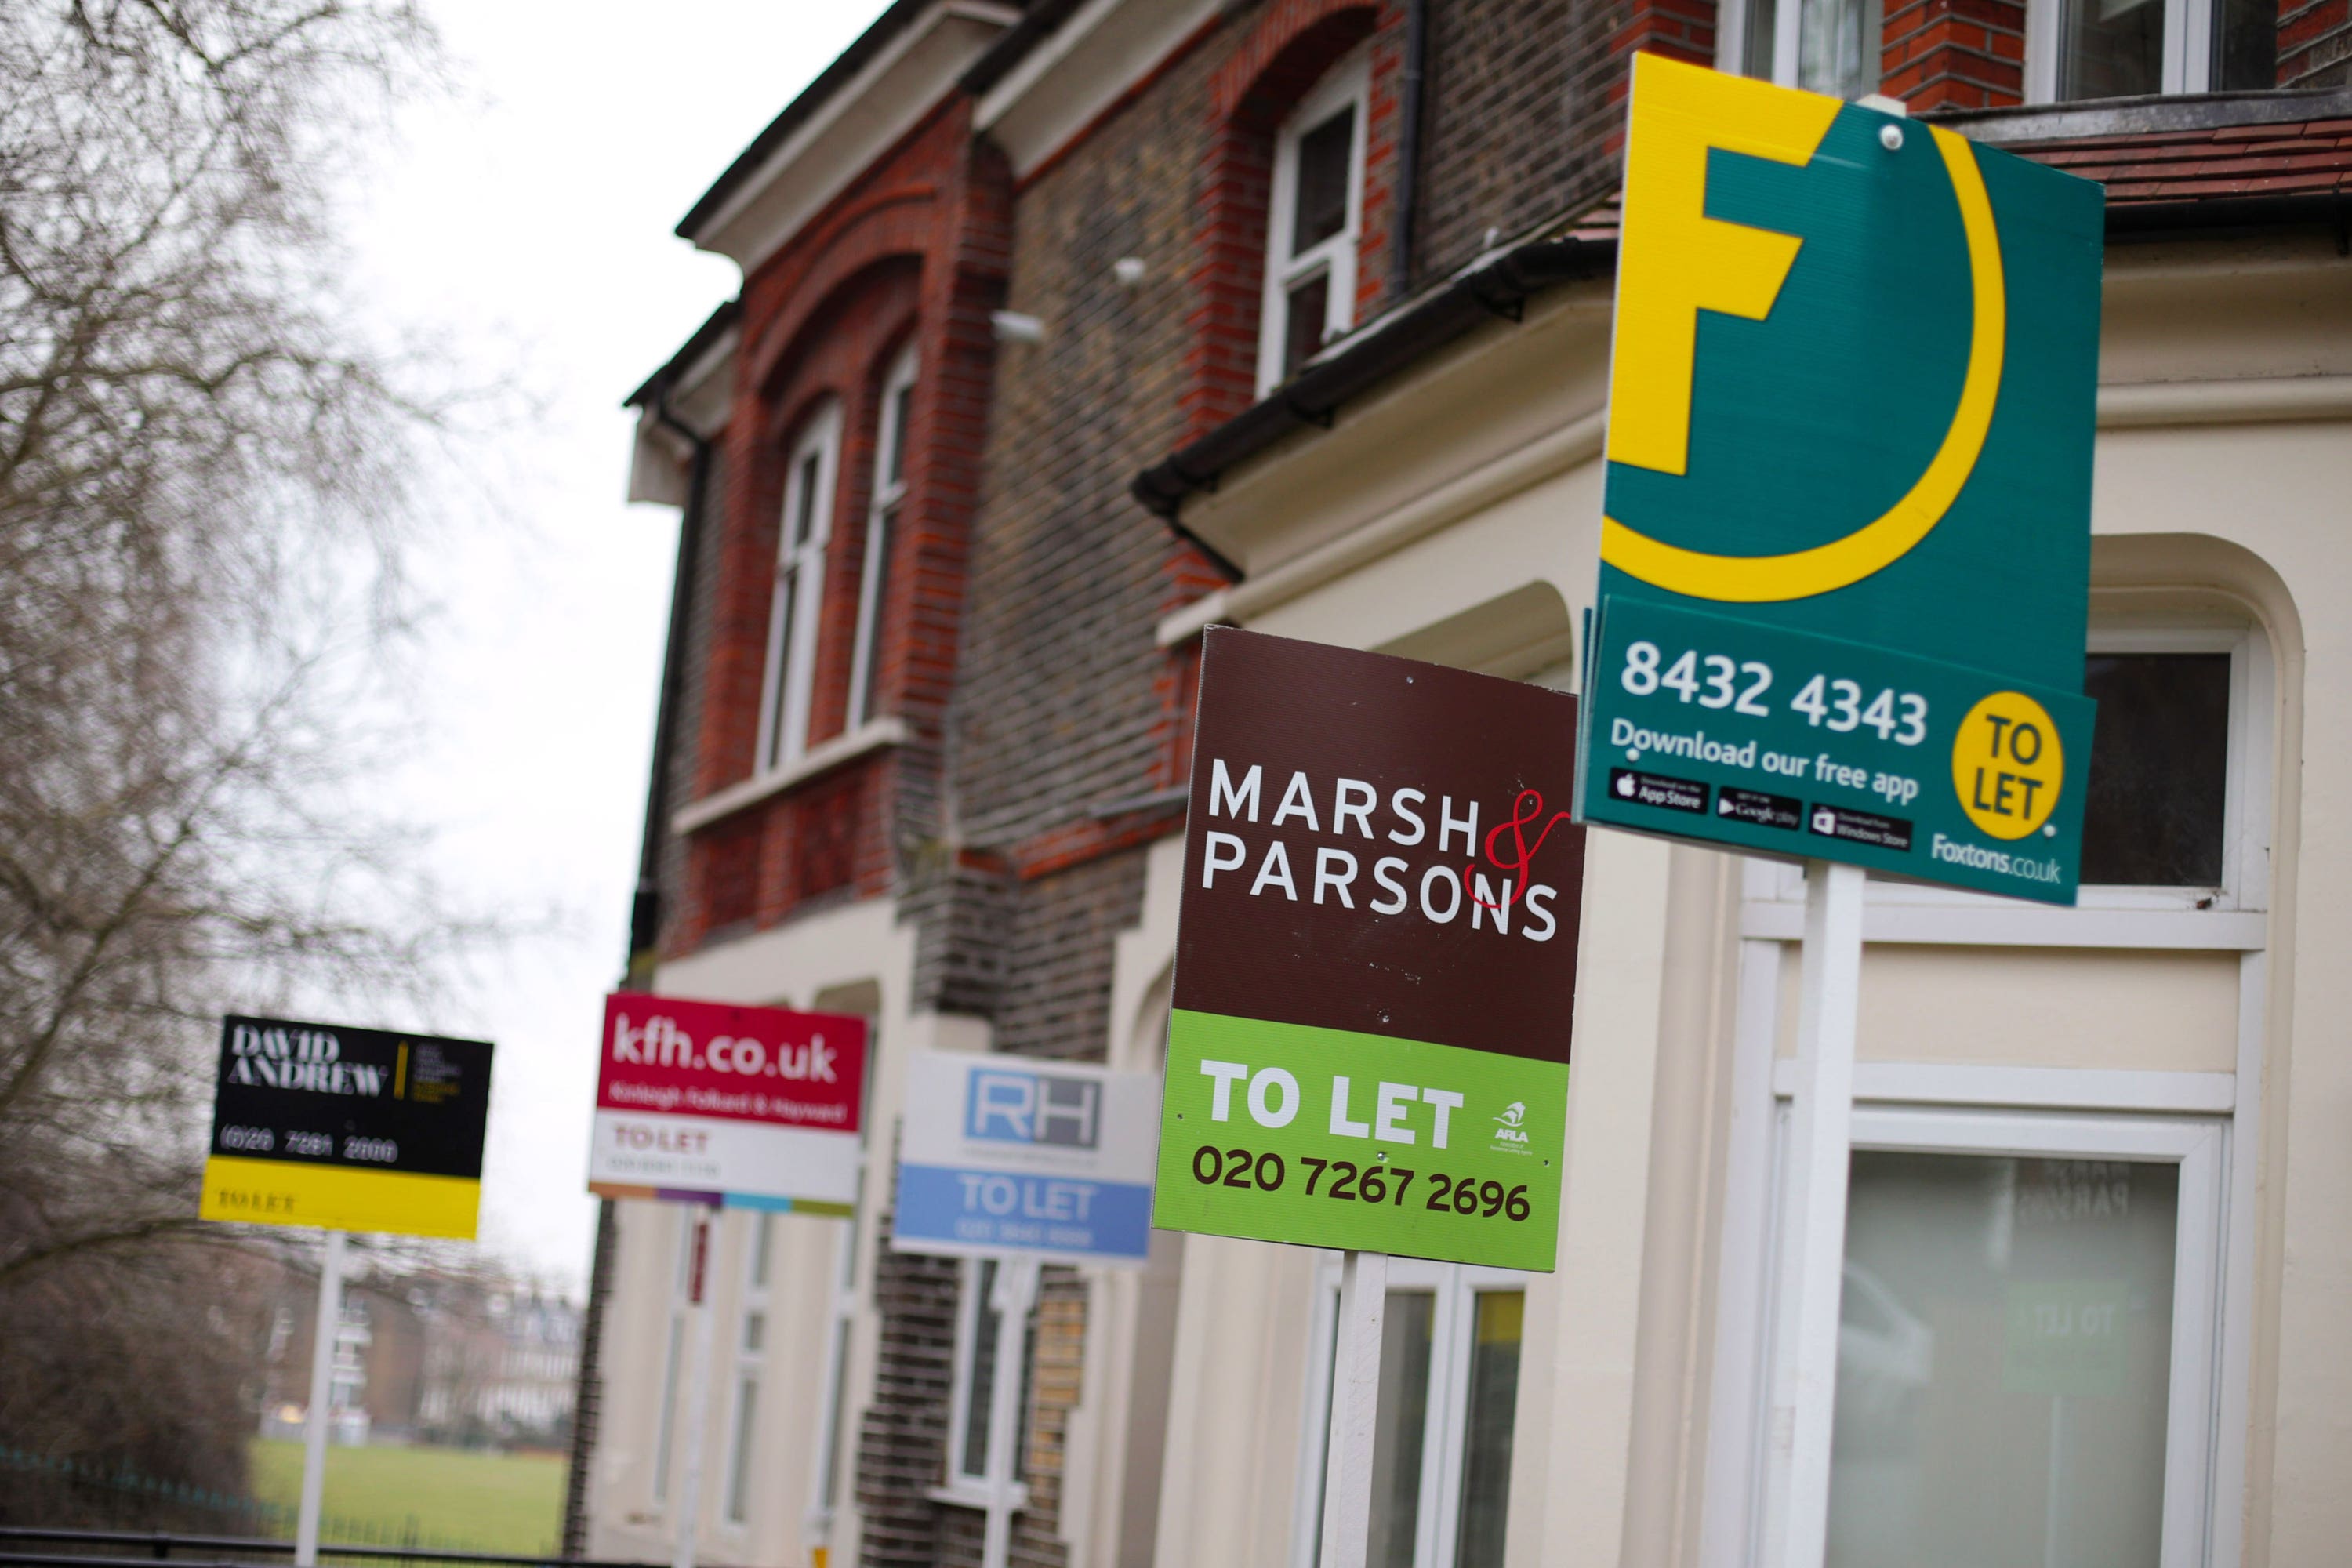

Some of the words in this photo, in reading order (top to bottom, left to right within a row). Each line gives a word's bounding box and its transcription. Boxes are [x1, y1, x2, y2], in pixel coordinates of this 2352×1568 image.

[1621, 641, 1773, 717] 8432
[1790, 674, 1927, 746] 4343
[1611, 718, 1757, 766] Download
[1762, 751, 1809, 779] our
[1815, 757, 1864, 789] free
[1872, 775, 1918, 806] app
[1985, 713, 2042, 767] TO
[1208, 759, 1479, 858] MARSH
[1639, 786, 1666, 804] App
[1667, 789, 1700, 808] Store
[1735, 803, 1773, 823] Google
[1973, 767, 2043, 821] LET
[1837, 824, 1882, 843] Windows
[1882, 832, 1908, 848] Store
[1931, 832, 2062, 884] Foxtons.co.uk
[1202, 831, 1557, 942] PARSONS
[233, 1024, 340, 1064] DAVID
[612, 1012, 838, 1084] kfh.co.uk
[228, 1056, 389, 1097] ANDREW
[975, 1075, 1094, 1145] RH
[1200, 1059, 1300, 1128] TO
[1329, 1076, 1464, 1150] LET
[613, 1123, 655, 1150] TO
[657, 1126, 711, 1154] LET
[1494, 1127, 1529, 1143] ARLA
[957, 1174, 1017, 1215] TO
[1022, 1178, 1098, 1221] LET
[1192, 1145, 1285, 1192] 020
[1300, 1157, 1414, 1206] 7267
[1425, 1173, 1530, 1221] 2696
